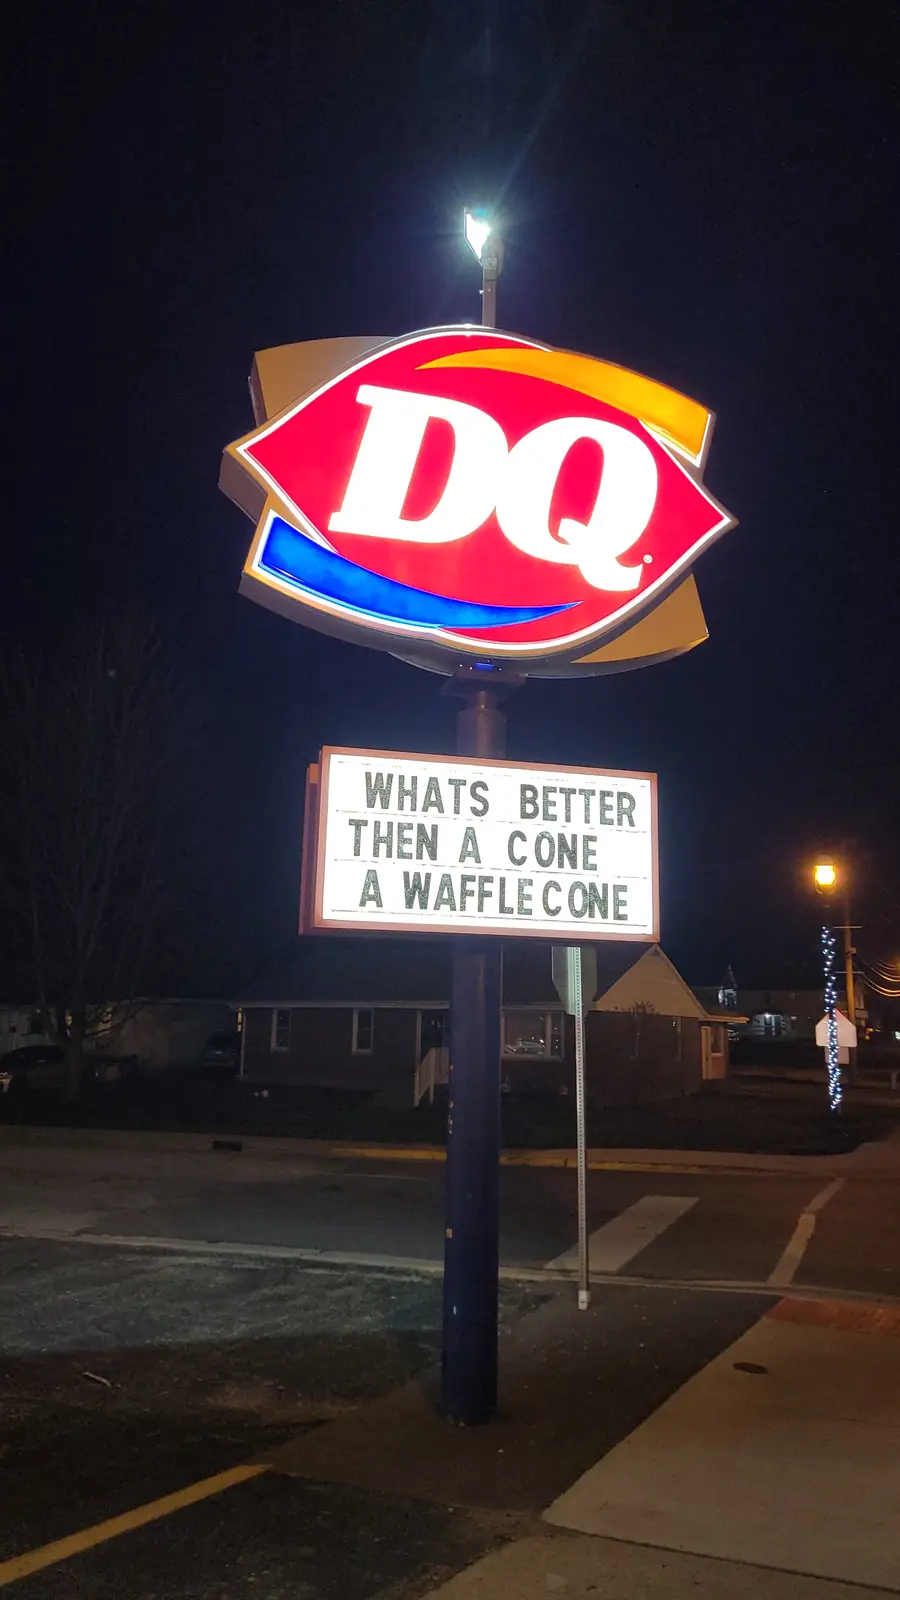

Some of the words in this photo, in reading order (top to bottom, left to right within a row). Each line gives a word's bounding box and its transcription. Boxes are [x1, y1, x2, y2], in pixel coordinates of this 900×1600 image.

[328, 384, 658, 592] DQ
[365, 771, 489, 817] WHATS
[520, 784, 636, 827] BETTER
[348, 819, 438, 860] THEN
[459, 826, 481, 864] A
[508, 830, 597, 871] CONE
[359, 869, 383, 907] A
